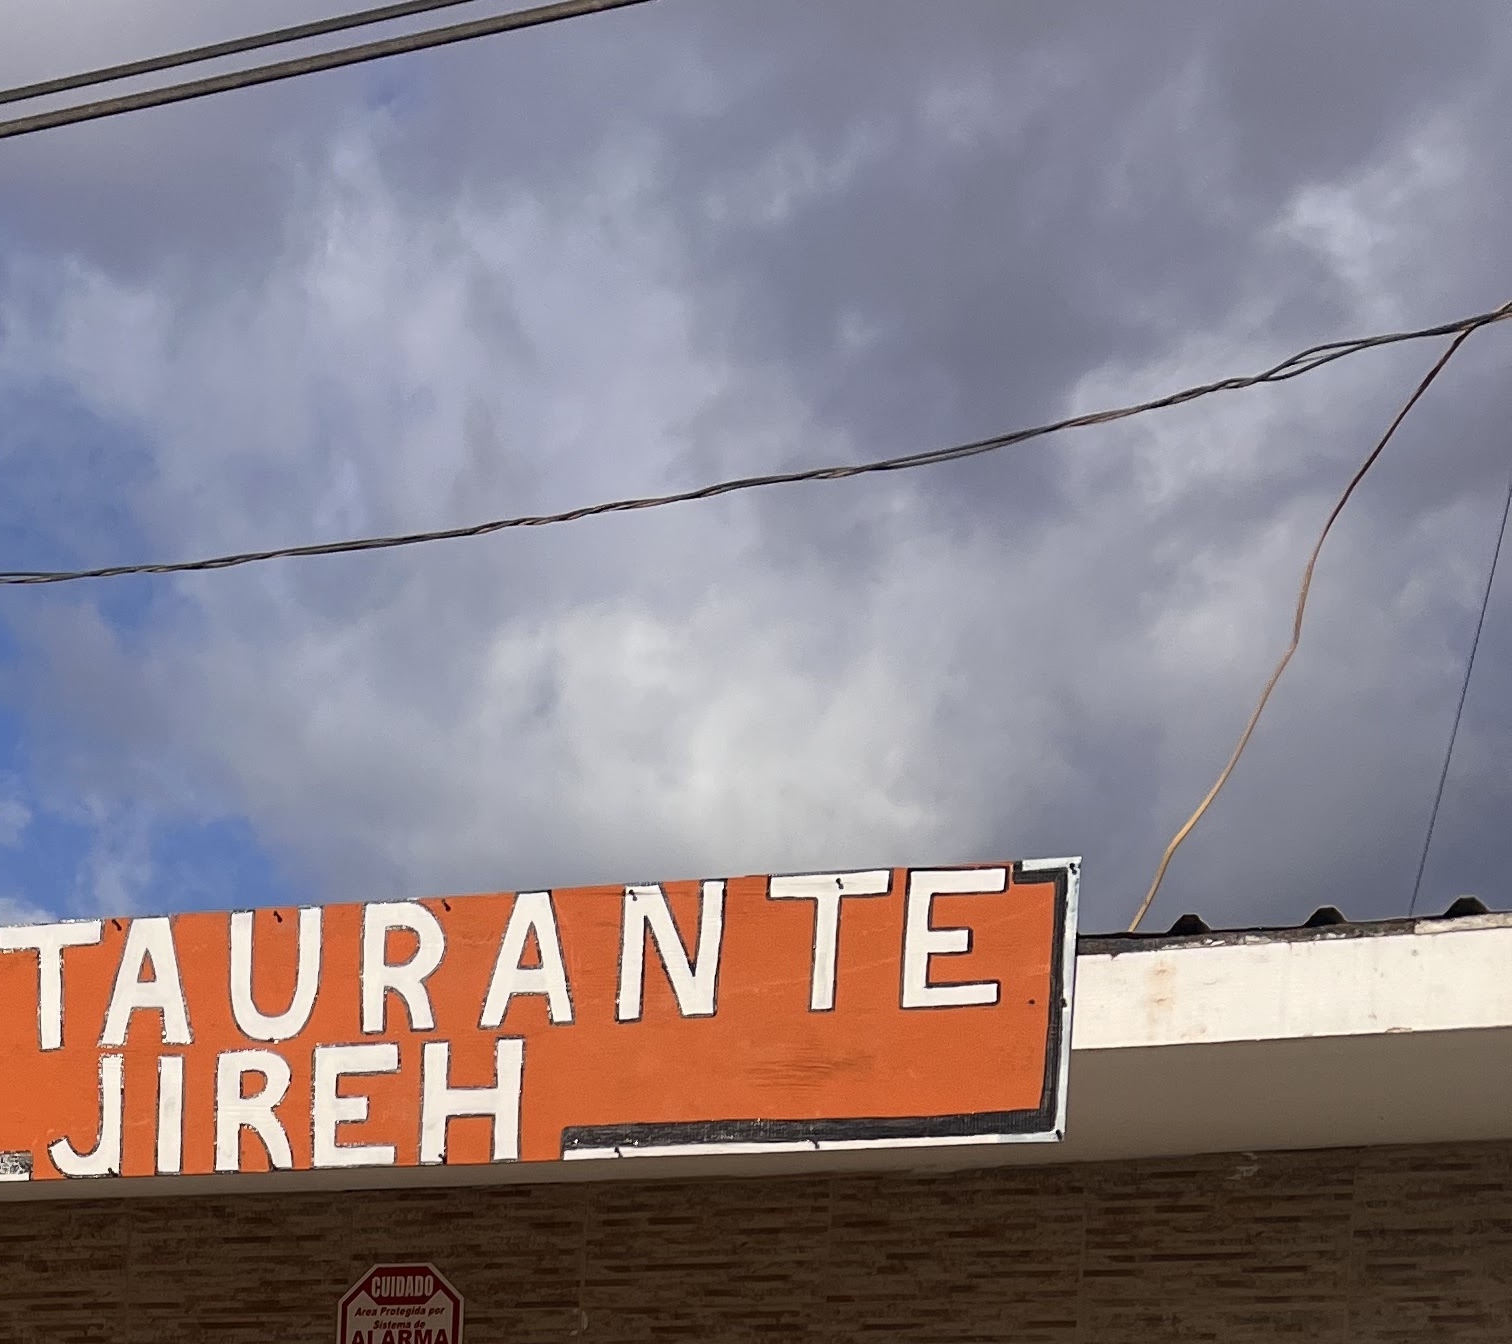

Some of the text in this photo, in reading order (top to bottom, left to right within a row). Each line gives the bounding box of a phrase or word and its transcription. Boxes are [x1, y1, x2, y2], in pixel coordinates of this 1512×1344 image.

[48, 1036, 526, 1180] JIREH
[371, 1275, 434, 1297] CUIDADO
[354, 1305, 445, 1318] Area Protegida por
[372, 1319, 426, 1330] Sistema de
